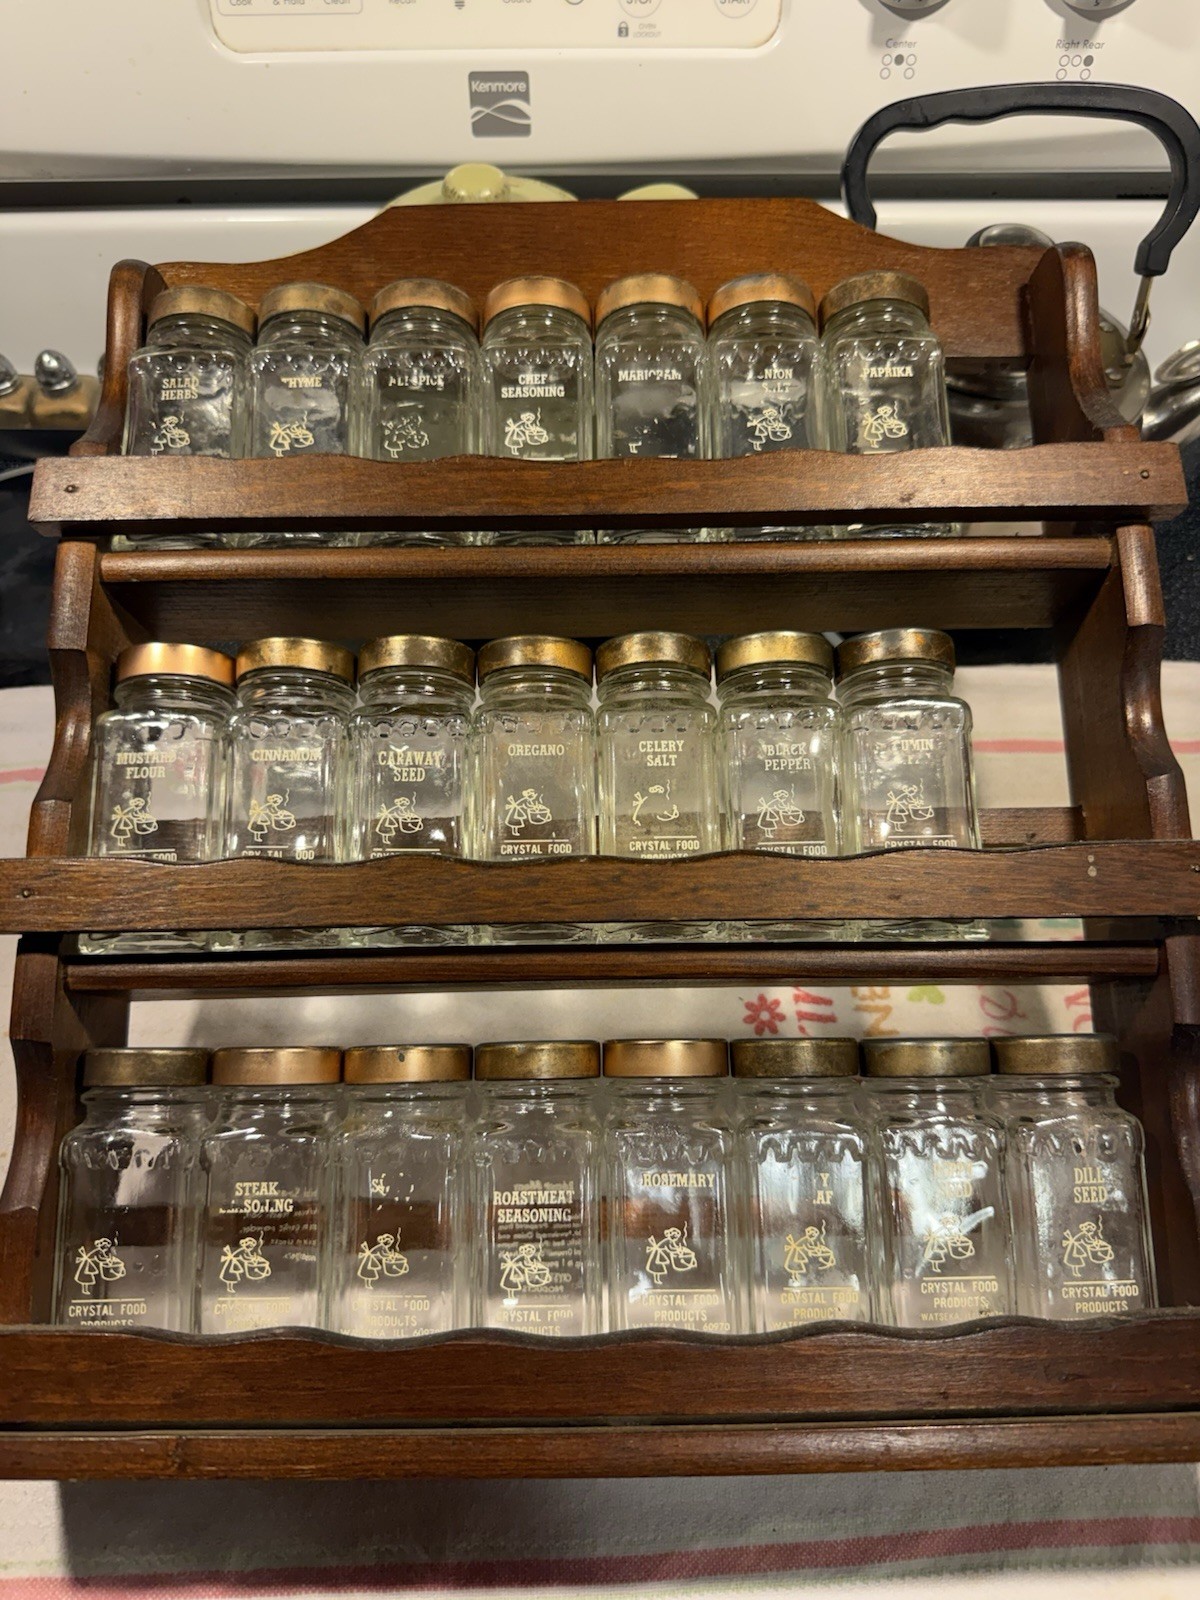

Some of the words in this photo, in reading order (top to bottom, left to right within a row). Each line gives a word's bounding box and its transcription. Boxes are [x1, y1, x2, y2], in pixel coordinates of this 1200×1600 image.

[885, 38, 918, 48] Center
[1055, 39, 1080, 51] Right
[1082, 39, 1106, 49] Rear
[471, 80, 527, 92] Kenmore
[757, 368, 793, 379] NION
[862, 366, 914, 378] PAPRIKA
[162, 376, 199, 389] SALAD
[518, 374, 548, 385] CHEF
[161, 389, 199, 400] HERBS
[501, 386, 565, 398] SEASONING
[507, 744, 565, 756] OREGANO
[638, 740, 685, 752] CELERY
[765, 743, 807, 756] BLACK
[646, 754, 678, 767] SALT
[764, 758, 812, 771] PEPPER
[126, 766, 166, 779] FLOUR
[393, 767, 426, 782] SEED
[500, 844, 543, 855] CRYSTAL
[629, 840, 671, 851] CRYSTAL
[676, 840, 700, 850] FOOD
[802, 845, 828, 855] FOOD
[642, 1173, 716, 1188] ROSEMARY
[1073, 1166, 1105, 1184] DILL
[234, 1181, 279, 1196] STEAK
[1073, 1185, 1108, 1204] SEED
[493, 1190, 575, 1205] ROASTMEAT
[497, 1207, 572, 1222] SEASONING
[920, 1281, 967, 1294] CRYSTAL
[972, 1280, 999, 1292] FOOD
[1061, 1286, 1108, 1298] CRYSTAL
[1112, 1284, 1139, 1296] FOOD
[641, 1294, 687, 1306] CRYSTAL
[781, 1291, 827, 1304] CRYSTAL
[933, 1297, 989, 1308] PRODUCTS
[68, 1304, 115, 1317] CRYSTAL
[120, 1302, 147, 1315] FOOD
[1075, 1300, 1129, 1313] PRODUCTS
[653, 1310, 708, 1321] PRODUCTS
